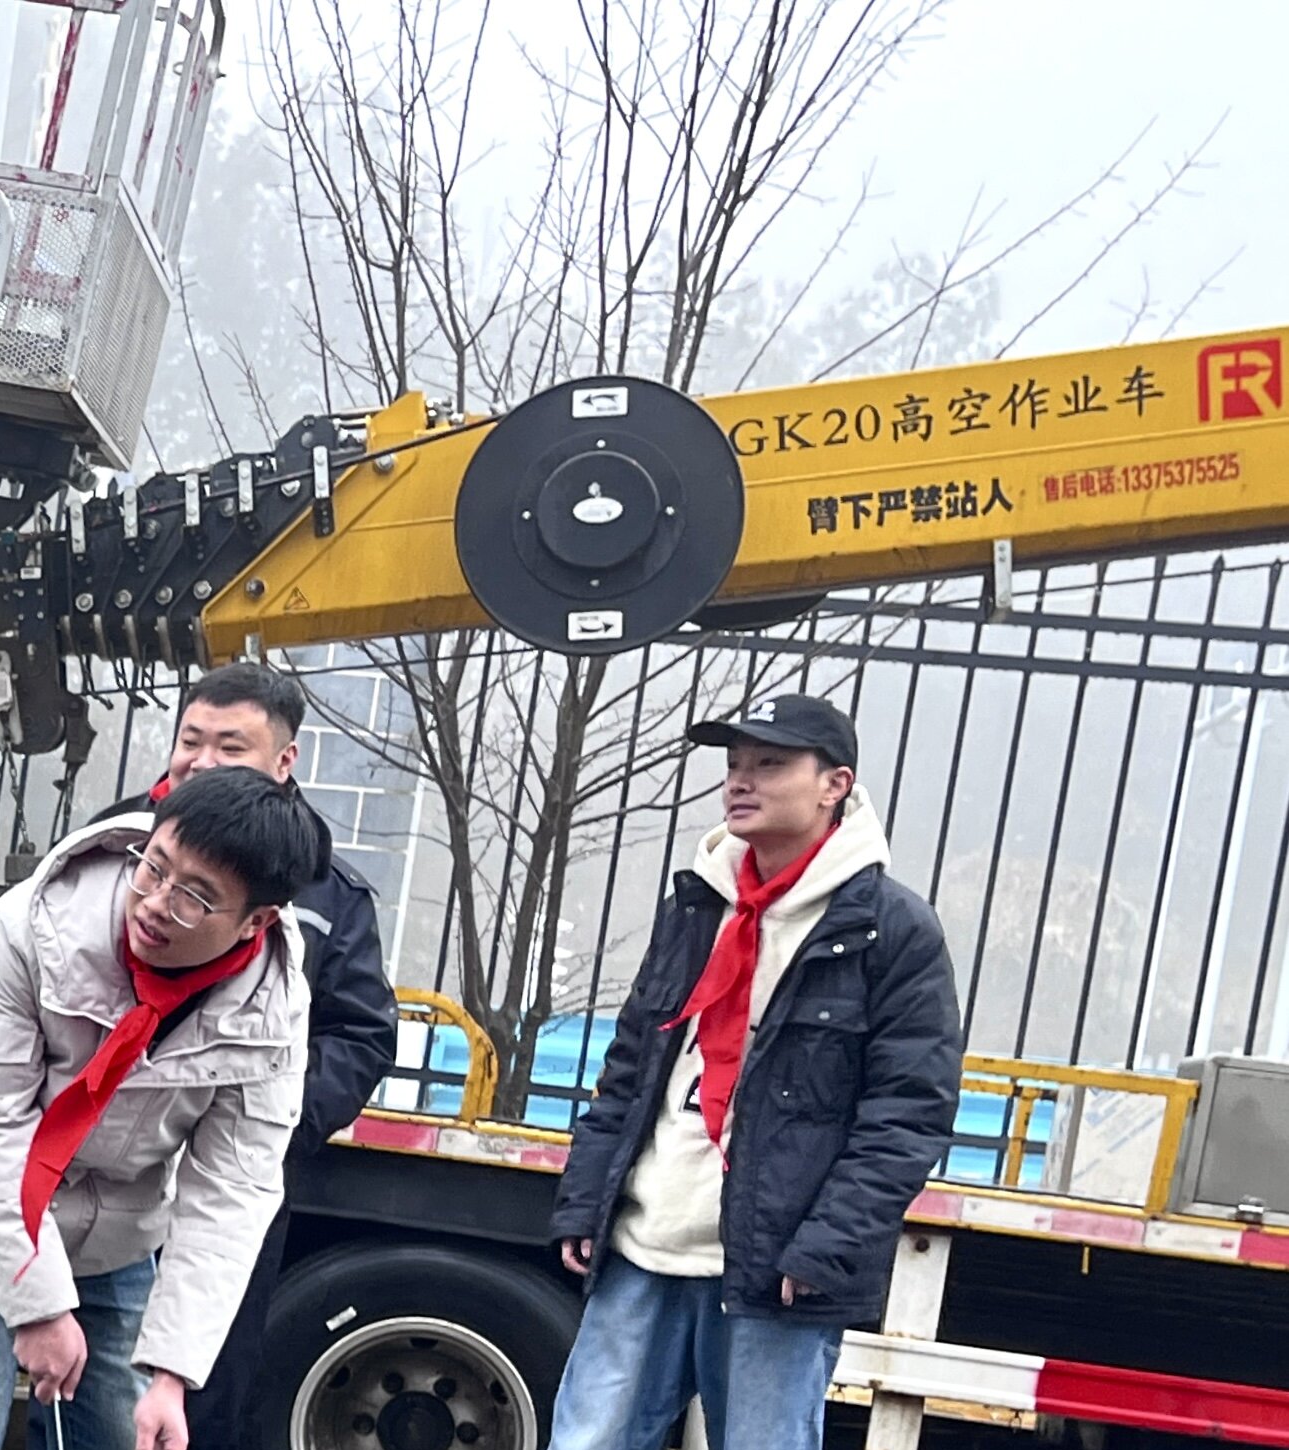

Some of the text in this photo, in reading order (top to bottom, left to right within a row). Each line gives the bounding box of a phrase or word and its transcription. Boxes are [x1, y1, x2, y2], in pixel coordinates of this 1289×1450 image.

[729, 365, 1166, 456] GK20高空作业车
[807, 477, 1014, 536] 臂下严禁站人
